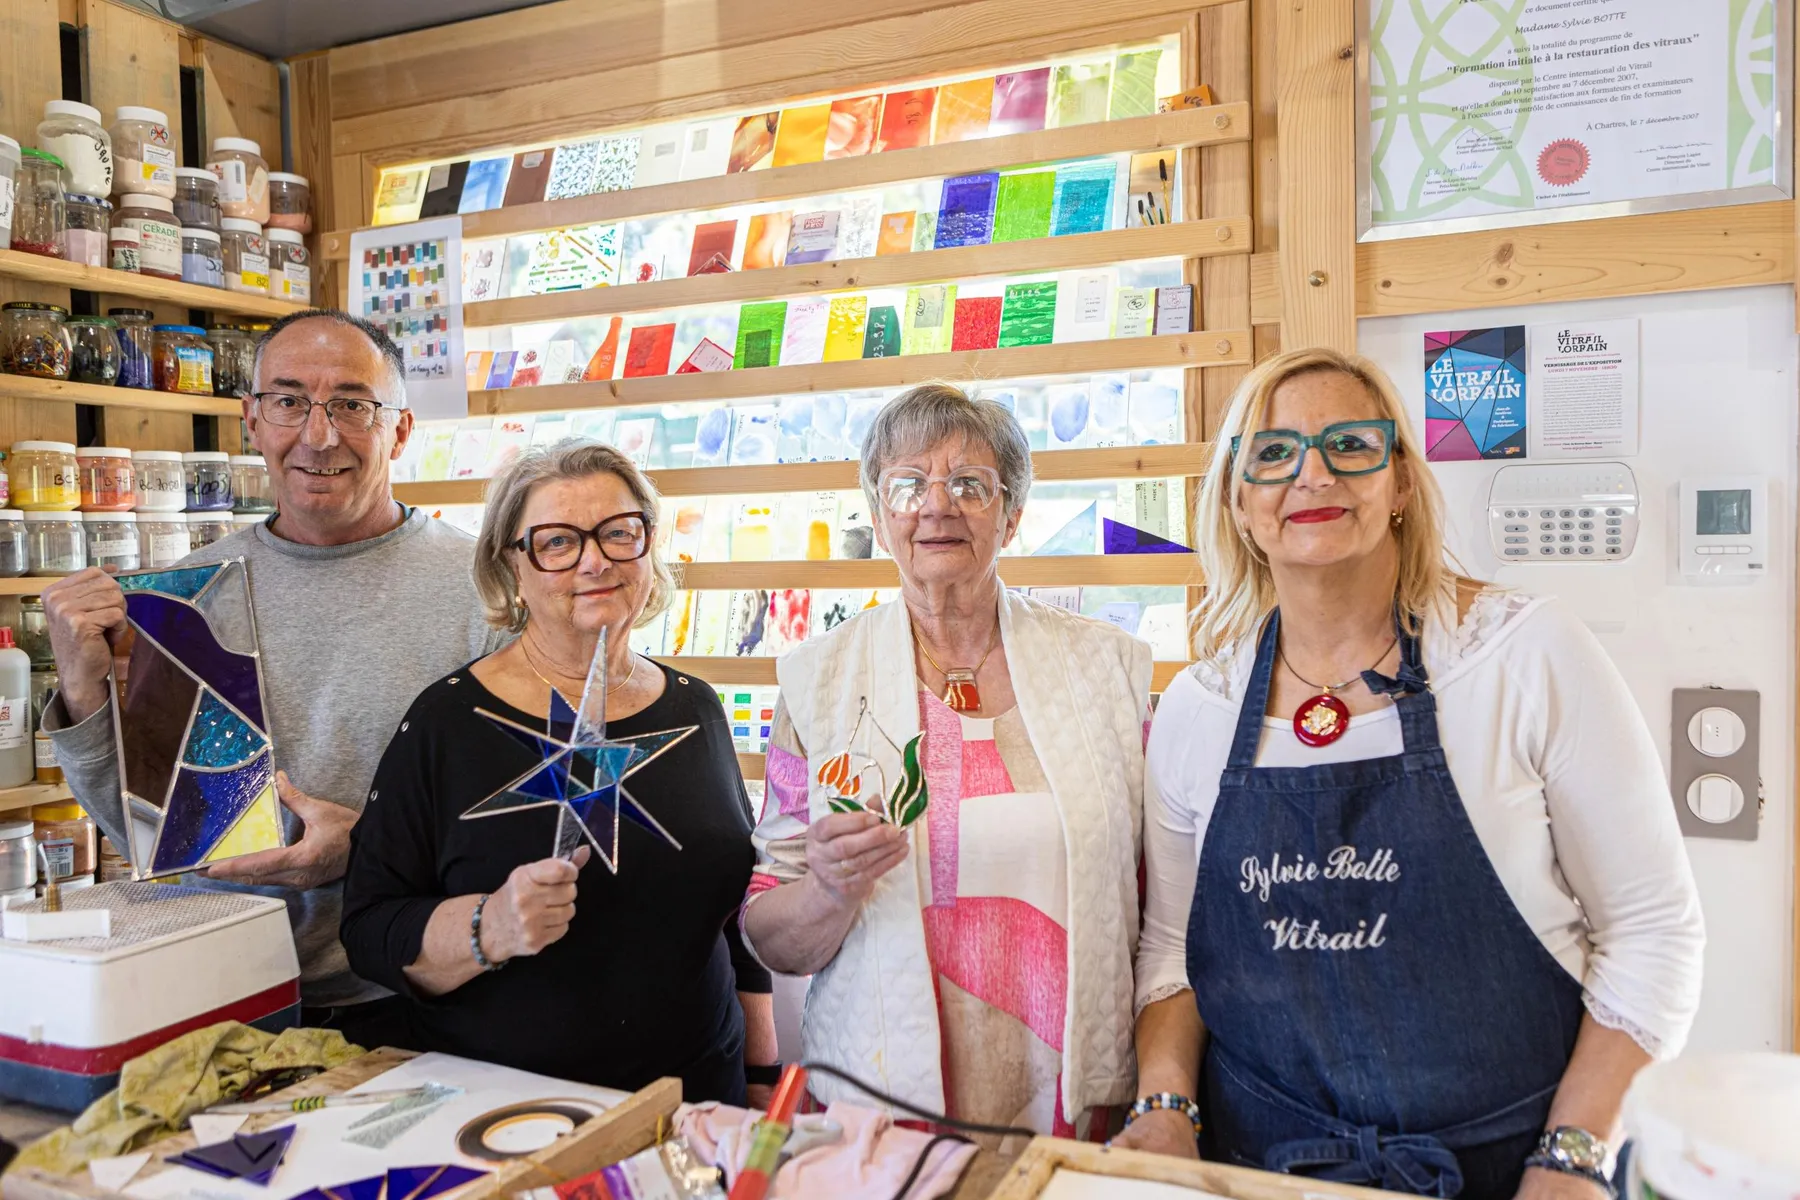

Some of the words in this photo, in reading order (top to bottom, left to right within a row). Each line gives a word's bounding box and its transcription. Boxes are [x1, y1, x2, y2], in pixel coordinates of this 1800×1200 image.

[1535, 3, 1571, 13] document
[1515, 21, 1560, 35] Madame
[1561, 18, 1591, 29] Sylvie
[1593, 11, 1627, 24] BOTTE
[1514, 44, 1531, 54] suivi
[1532, 43, 1540, 51] la
[1541, 39, 1567, 51] totalité
[1568, 38, 1578, 47] du
[1579, 33, 1622, 47] programme
[1623, 31, 1633, 39] de
[1507, 54, 1542, 68] initiale
[1545, 52, 1551, 62] à
[1554, 50, 1563, 60] la
[1566, 44, 1630, 60] restauration
[1633, 40, 1650, 51] des
[1489, 76, 1519, 89] dispensé
[1521, 78, 1532, 89] par
[1534, 75, 1541, 83] le
[1542, 72, 1567, 83] Centre
[1569, 66, 1615, 78] international
[1617, 65, 1627, 73] du
[1628, 61, 1653, 72] Vitrail
[1502, 88, 1511, 96] du
[1524, 82, 1560, 95] septembre
[1580, 75, 1615, 87] décembre
[1460, 102, 1483, 115] qu'elle
[1490, 98, 1512, 107] donné
[1514, 96, 1532, 104] toute
[1534, 90, 1575, 102] satisfaction
[1576, 89, 1590, 97] aux
[1592, 84, 1632, 95] formateurs
[1642, 77, 1693, 89] examinateurs
[1467, 108, 1502, 119] l'occasion
[1504, 106, 1513, 115] du
[1515, 102, 1544, 114] contrôle
[1546, 101, 1554, 110] de
[1556, 95, 1608, 109] connaissances
[1609, 94, 1619, 102] de
[1620, 92, 1631, 101] fin
[1633, 91, 1642, 99] de
[1644, 87, 1682, 98] formation
[1586, 122, 1593, 131] À
[1595, 119, 1629, 130] Chartres,
[1630, 118, 1637, 126] le
[1646, 114, 1680, 125] décembre
[1682, 112, 1700, 121] 2007
[143, 223, 180, 239] CERADEL
[1557, 329, 1571, 338] LE
[1557, 335, 1604, 346] VITRAIL
[1557, 343, 1608, 354] LORRAIN
[1430, 358, 1454, 374] LE
[1430, 369, 1514, 389] VITRAIL
[1430, 383, 1521, 402] LORRAIN
[1239, 852, 1320, 903] Sylvie
[1263, 912, 1388, 951] Vitrail
